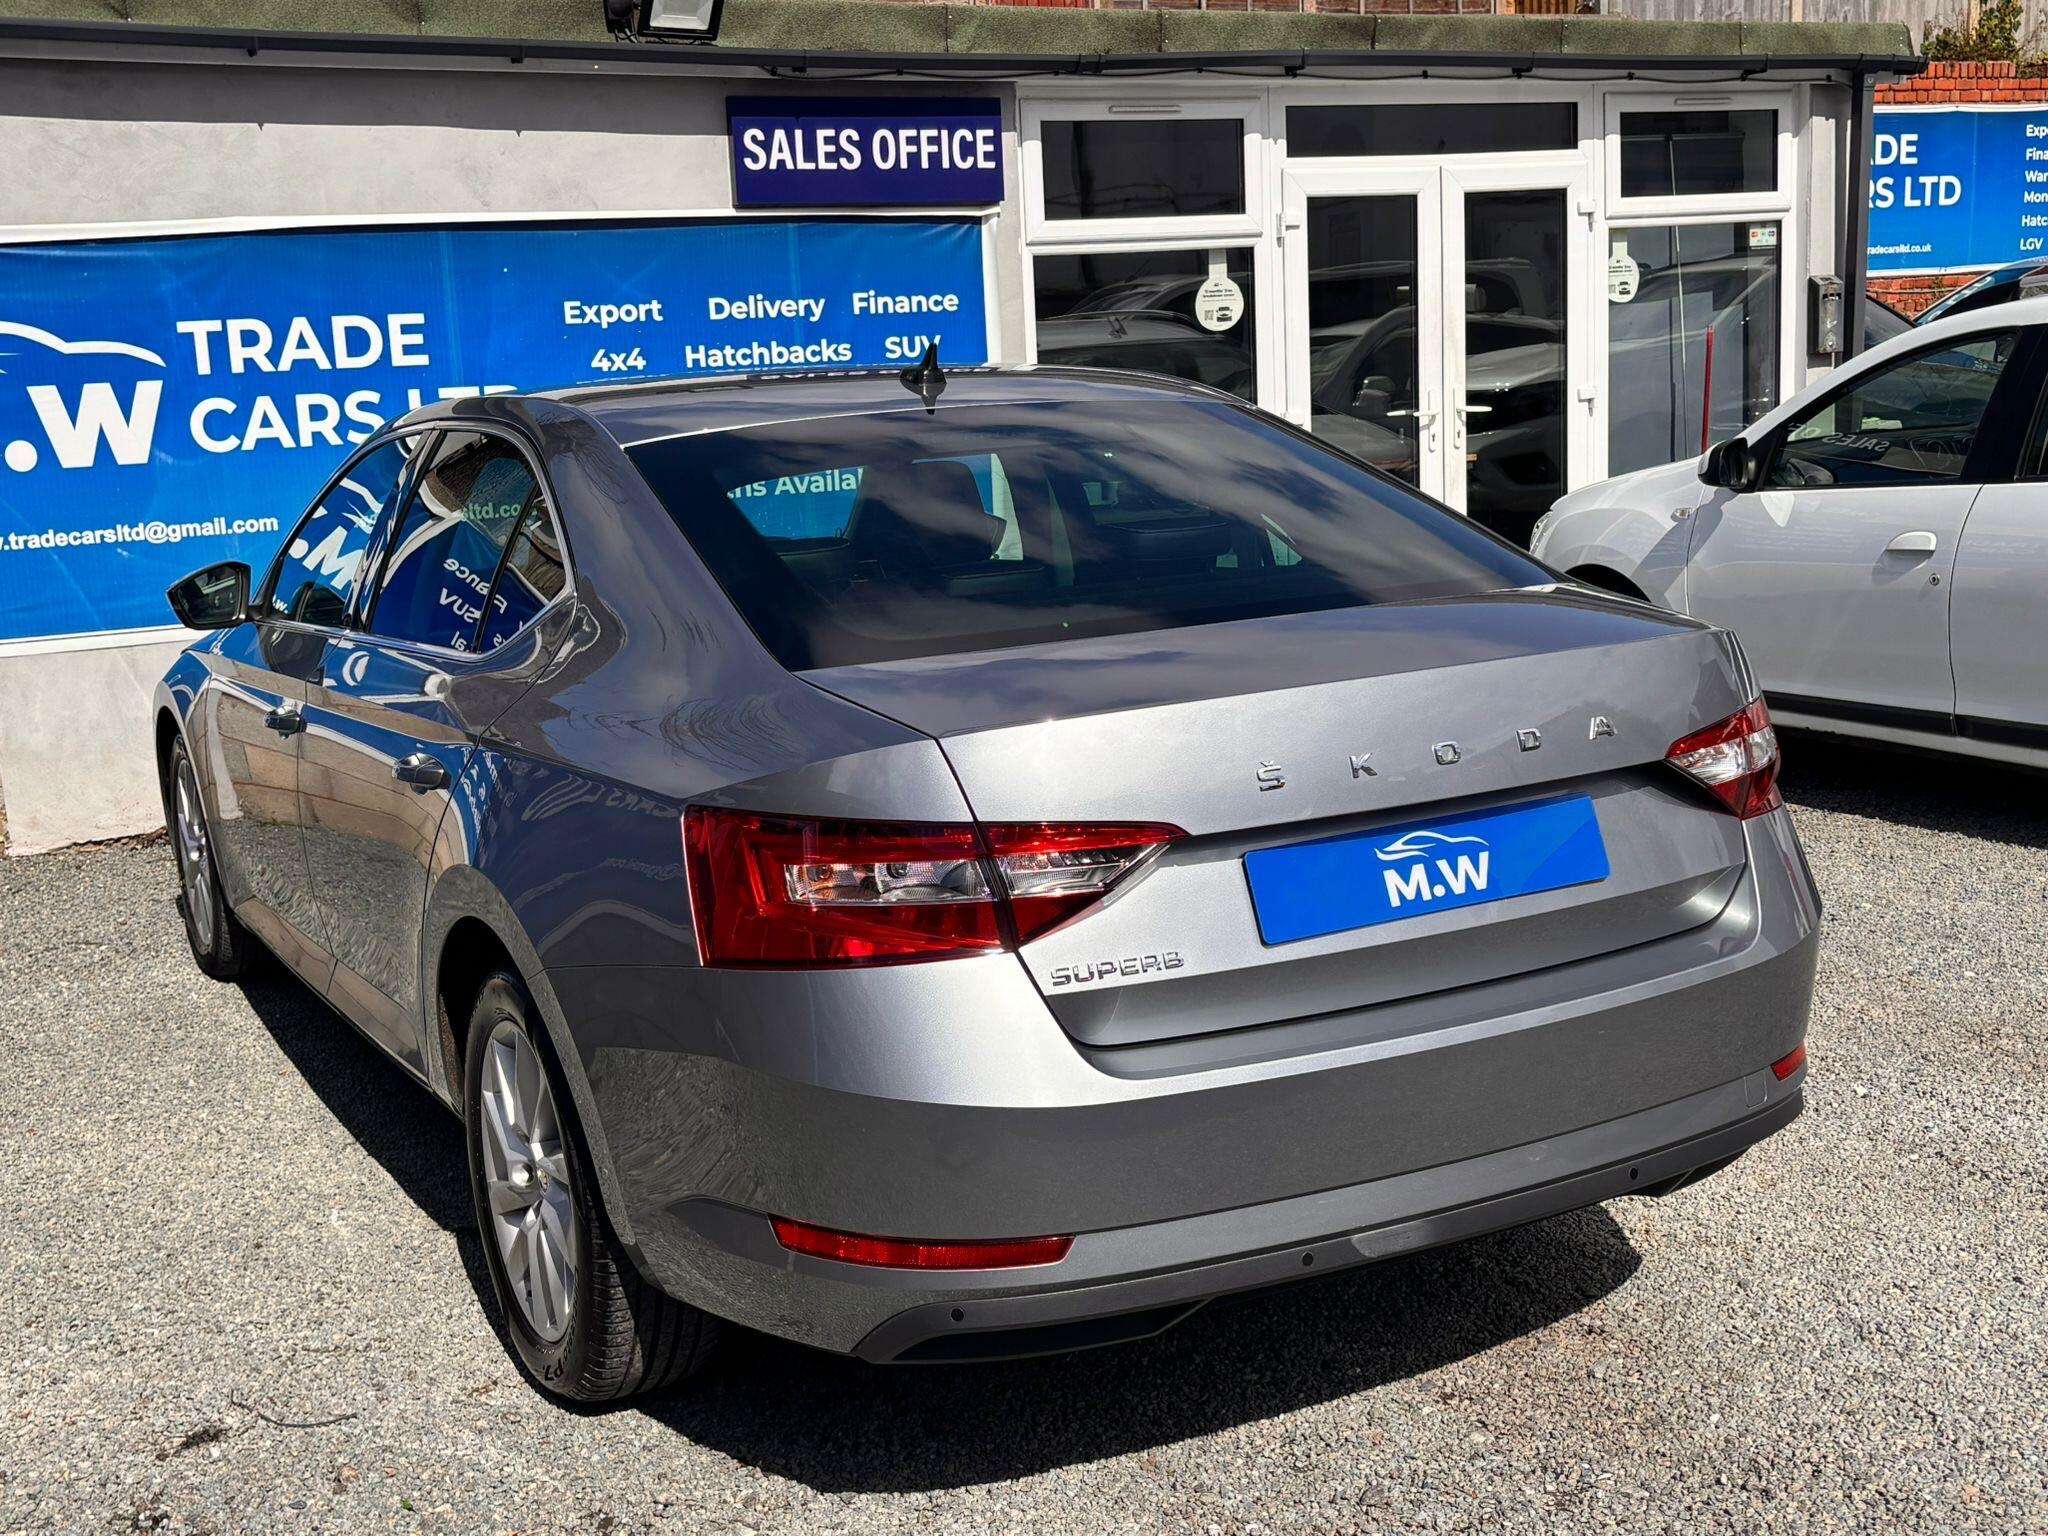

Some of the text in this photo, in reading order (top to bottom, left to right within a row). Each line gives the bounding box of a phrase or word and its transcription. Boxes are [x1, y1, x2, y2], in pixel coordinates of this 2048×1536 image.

[743, 128, 997, 171] SALES OFFICE
[1869, 133, 1919, 166] DE
[1904, 175, 1962, 207] LTD
[2020, 237, 2043, 251] LGV
[563, 290, 959, 329] Export Delivery Finance
[176, 313, 430, 376] TRADE
[591, 347, 647, 372] 4x4
[685, 338, 852, 369] Hatchbacks
[190, 390, 386, 454] CARS
[1381, 850, 1490, 908] M.W
[1050, 951, 1186, 987] SUPERB
